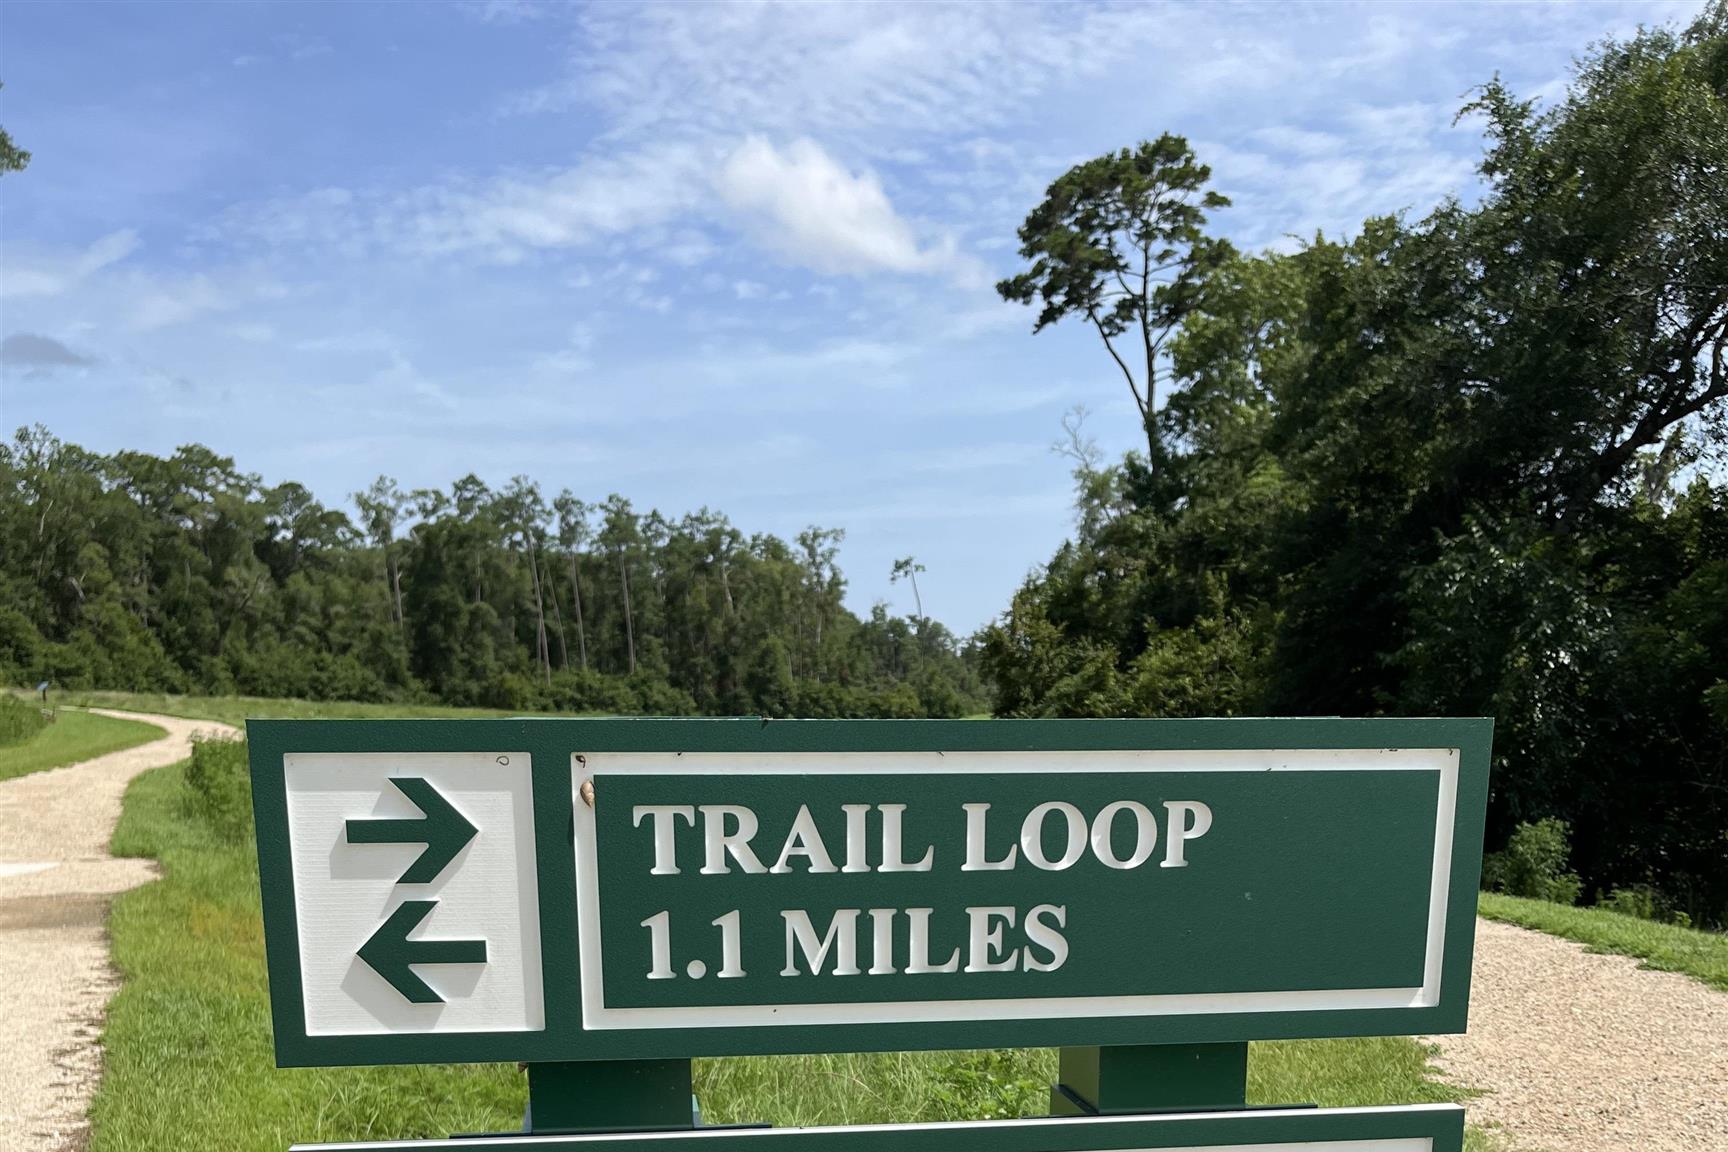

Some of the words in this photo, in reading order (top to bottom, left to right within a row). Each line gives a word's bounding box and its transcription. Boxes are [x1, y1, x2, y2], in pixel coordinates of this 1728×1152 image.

[633, 804, 934, 874] TRAIL
[961, 800, 1213, 871] LOOP
[641, 910, 746, 980] 1.1
[780, 904, 1069, 976] MILES
